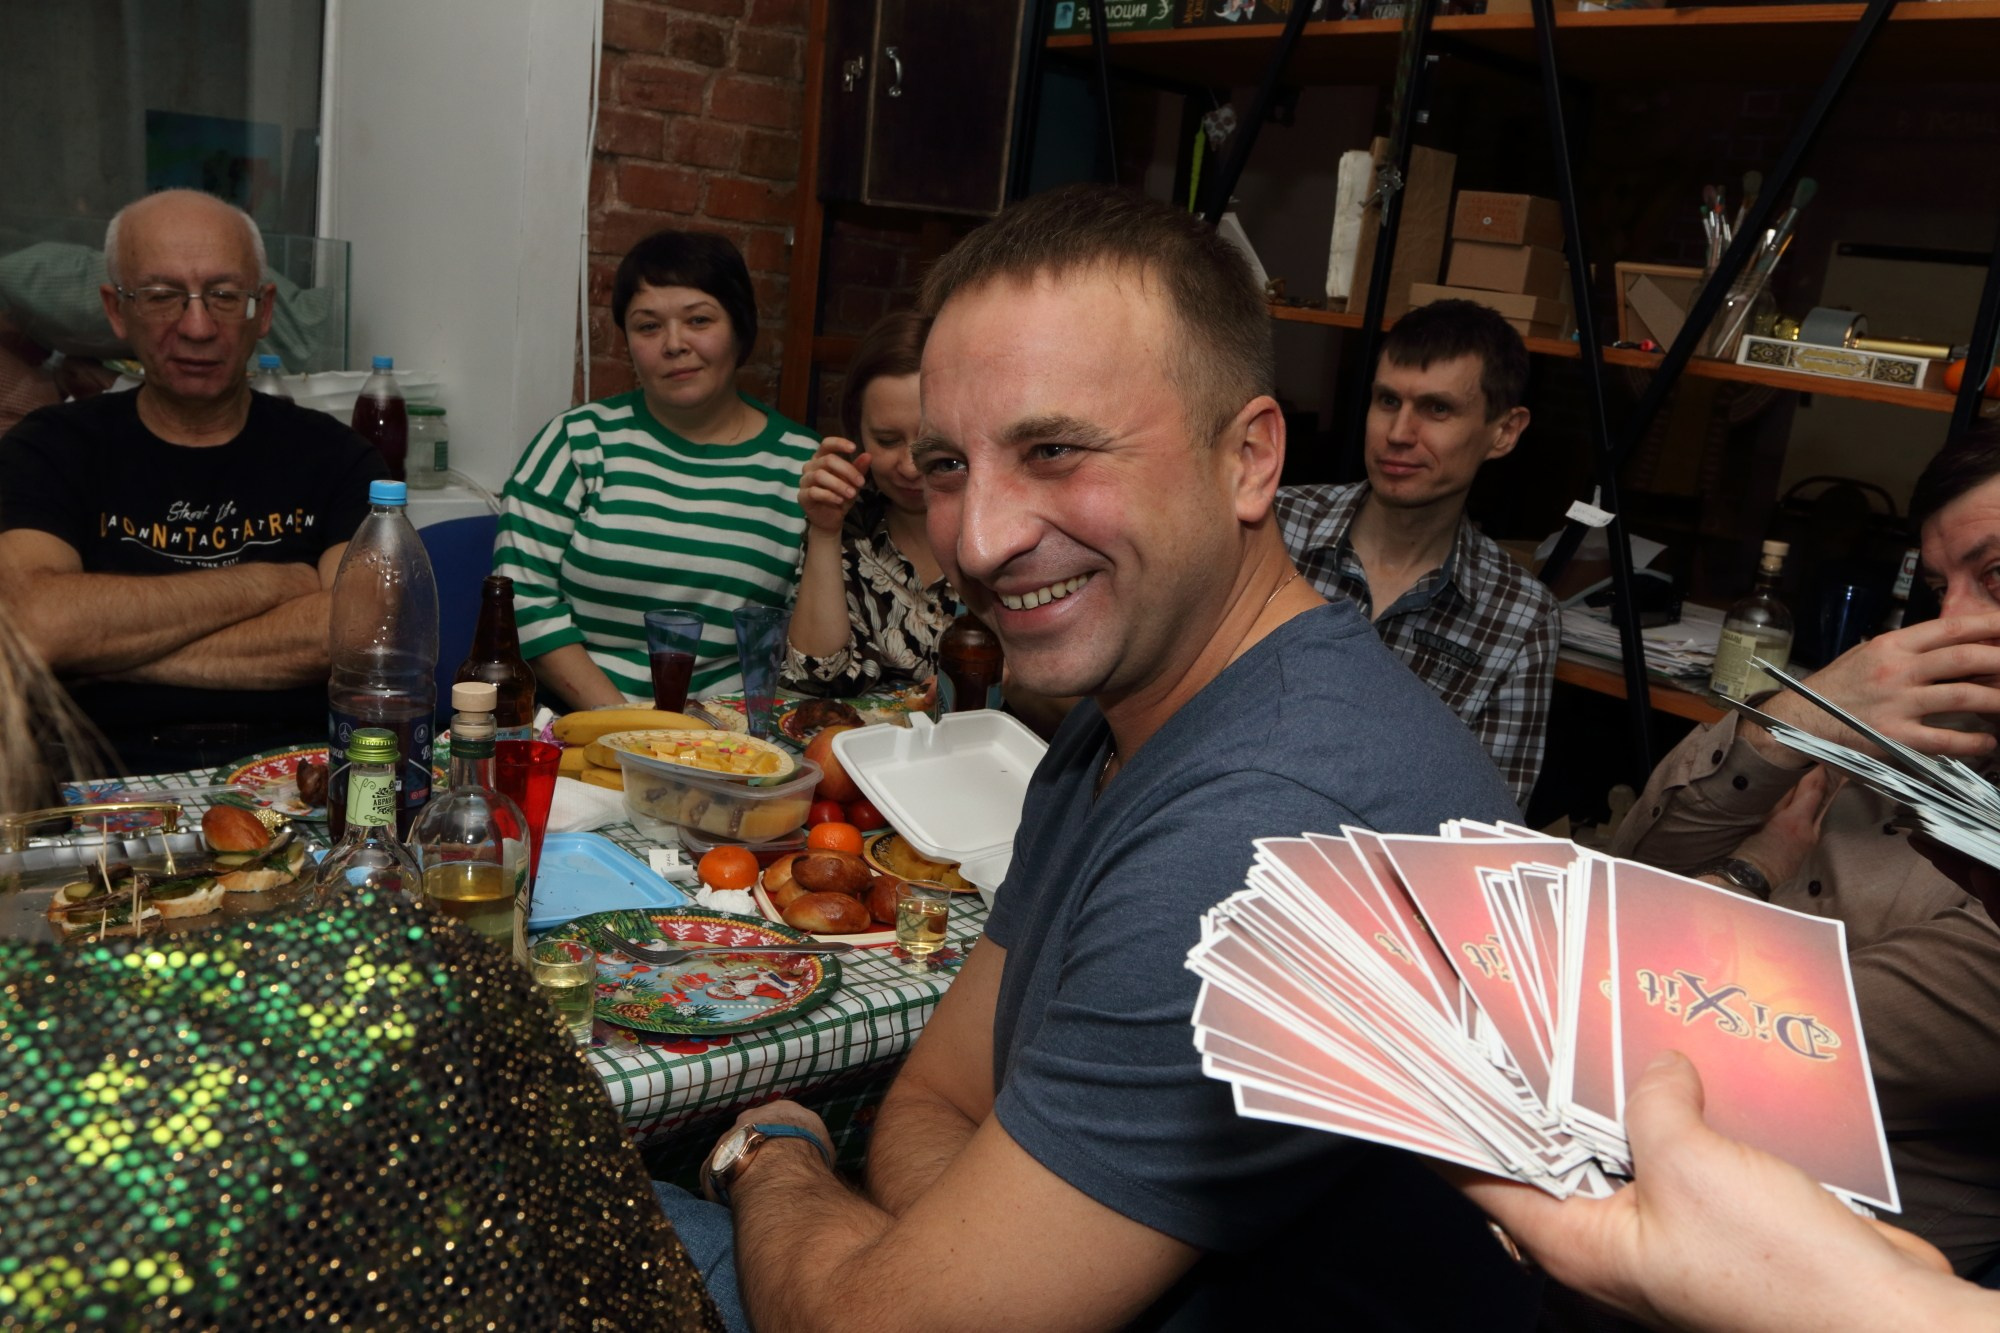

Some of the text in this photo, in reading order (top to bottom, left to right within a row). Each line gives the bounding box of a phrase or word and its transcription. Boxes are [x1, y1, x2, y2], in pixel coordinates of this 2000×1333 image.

[167, 500, 238, 524] Street Life
[1636, 968, 1841, 1061] DiXit
